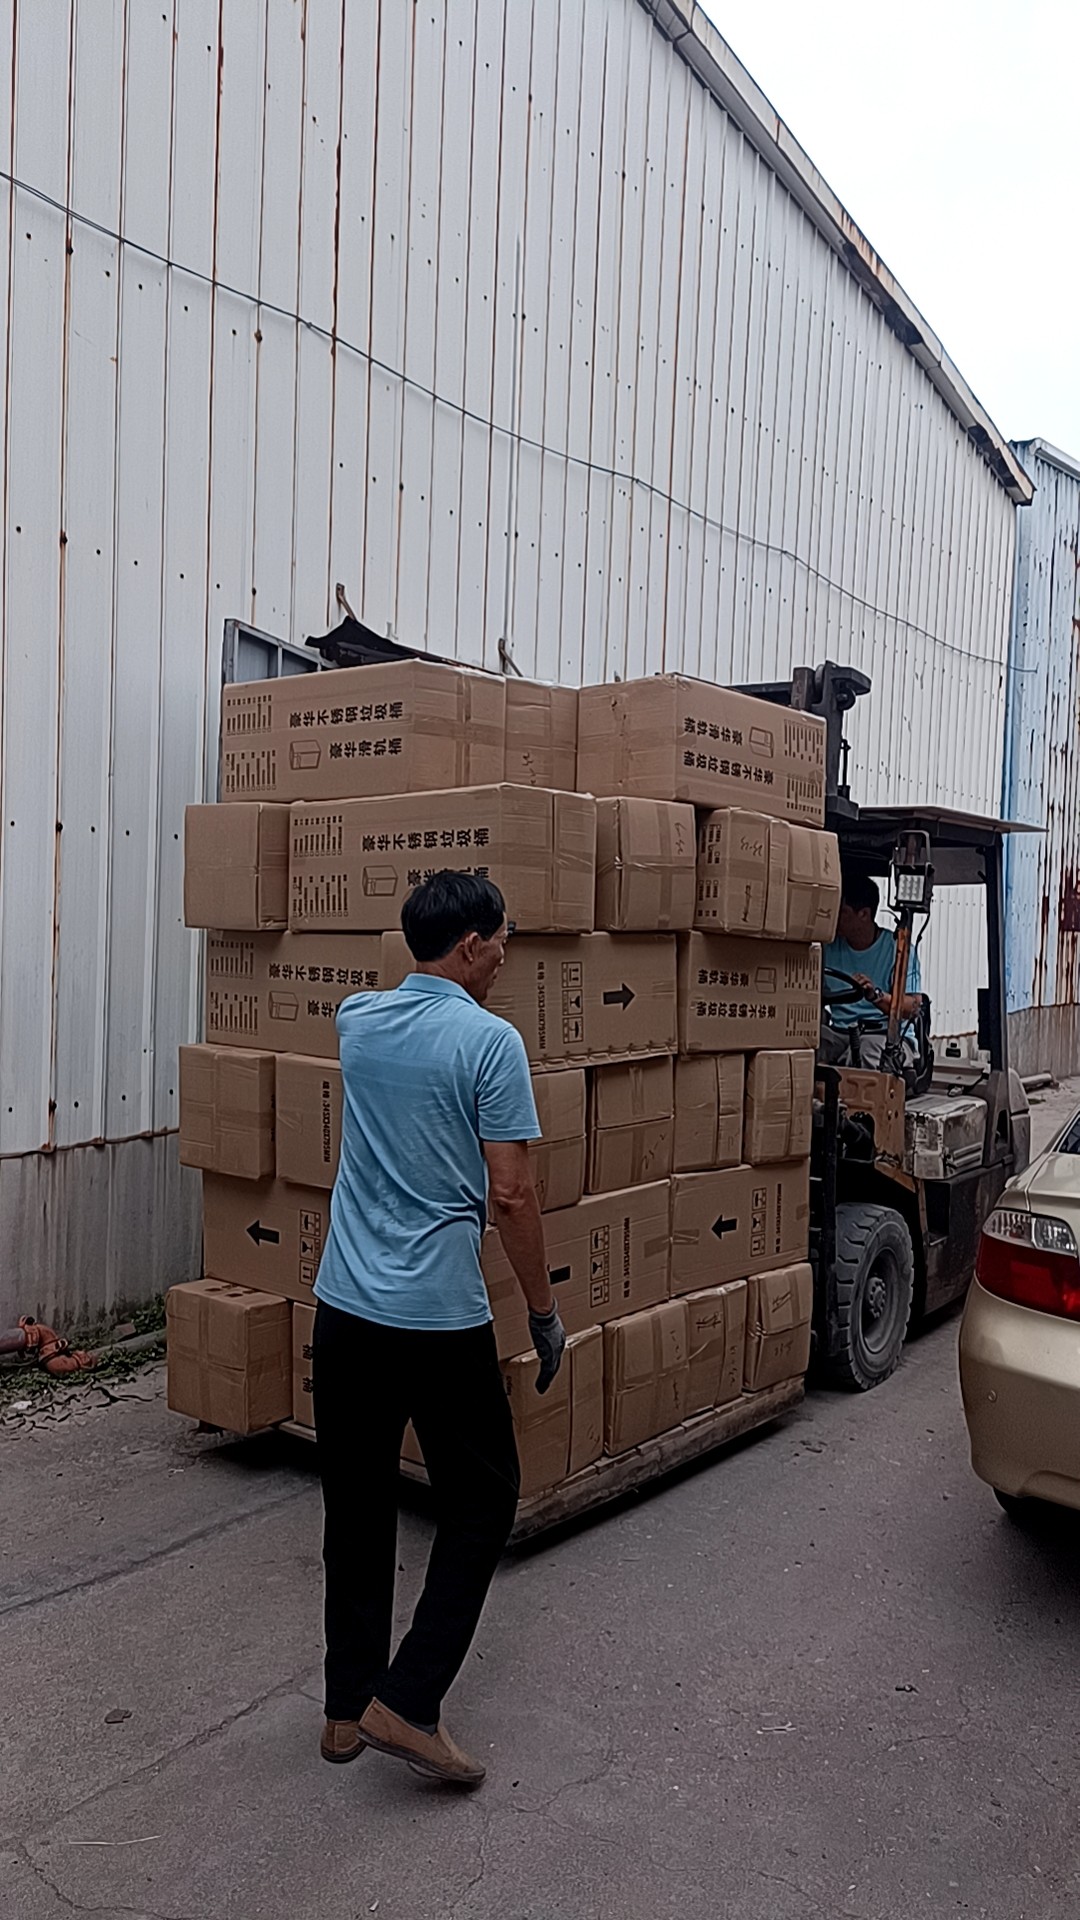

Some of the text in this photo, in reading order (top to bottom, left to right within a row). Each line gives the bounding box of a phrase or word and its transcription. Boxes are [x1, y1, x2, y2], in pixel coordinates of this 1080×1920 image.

[290, 702, 403, 728] 豪华不锈钢垃圾桶
[684, 717, 743, 747] 豪华滑轨桶
[329, 738, 403, 760] 豪华滑轨桶
[684, 751, 774, 785] 豪华不锈钢垃圾桶
[362, 827, 490, 852] 豪华不锈钢垃圾桶
[269, 963, 379, 988] 豪华不锈钢垃圾桶
[698, 969, 749, 987] 豪华滑轨桶
[308, 1000, 341, 1018] 豪华
[696, 1001, 776, 1019] 豪华不锈钢垃圾桶
